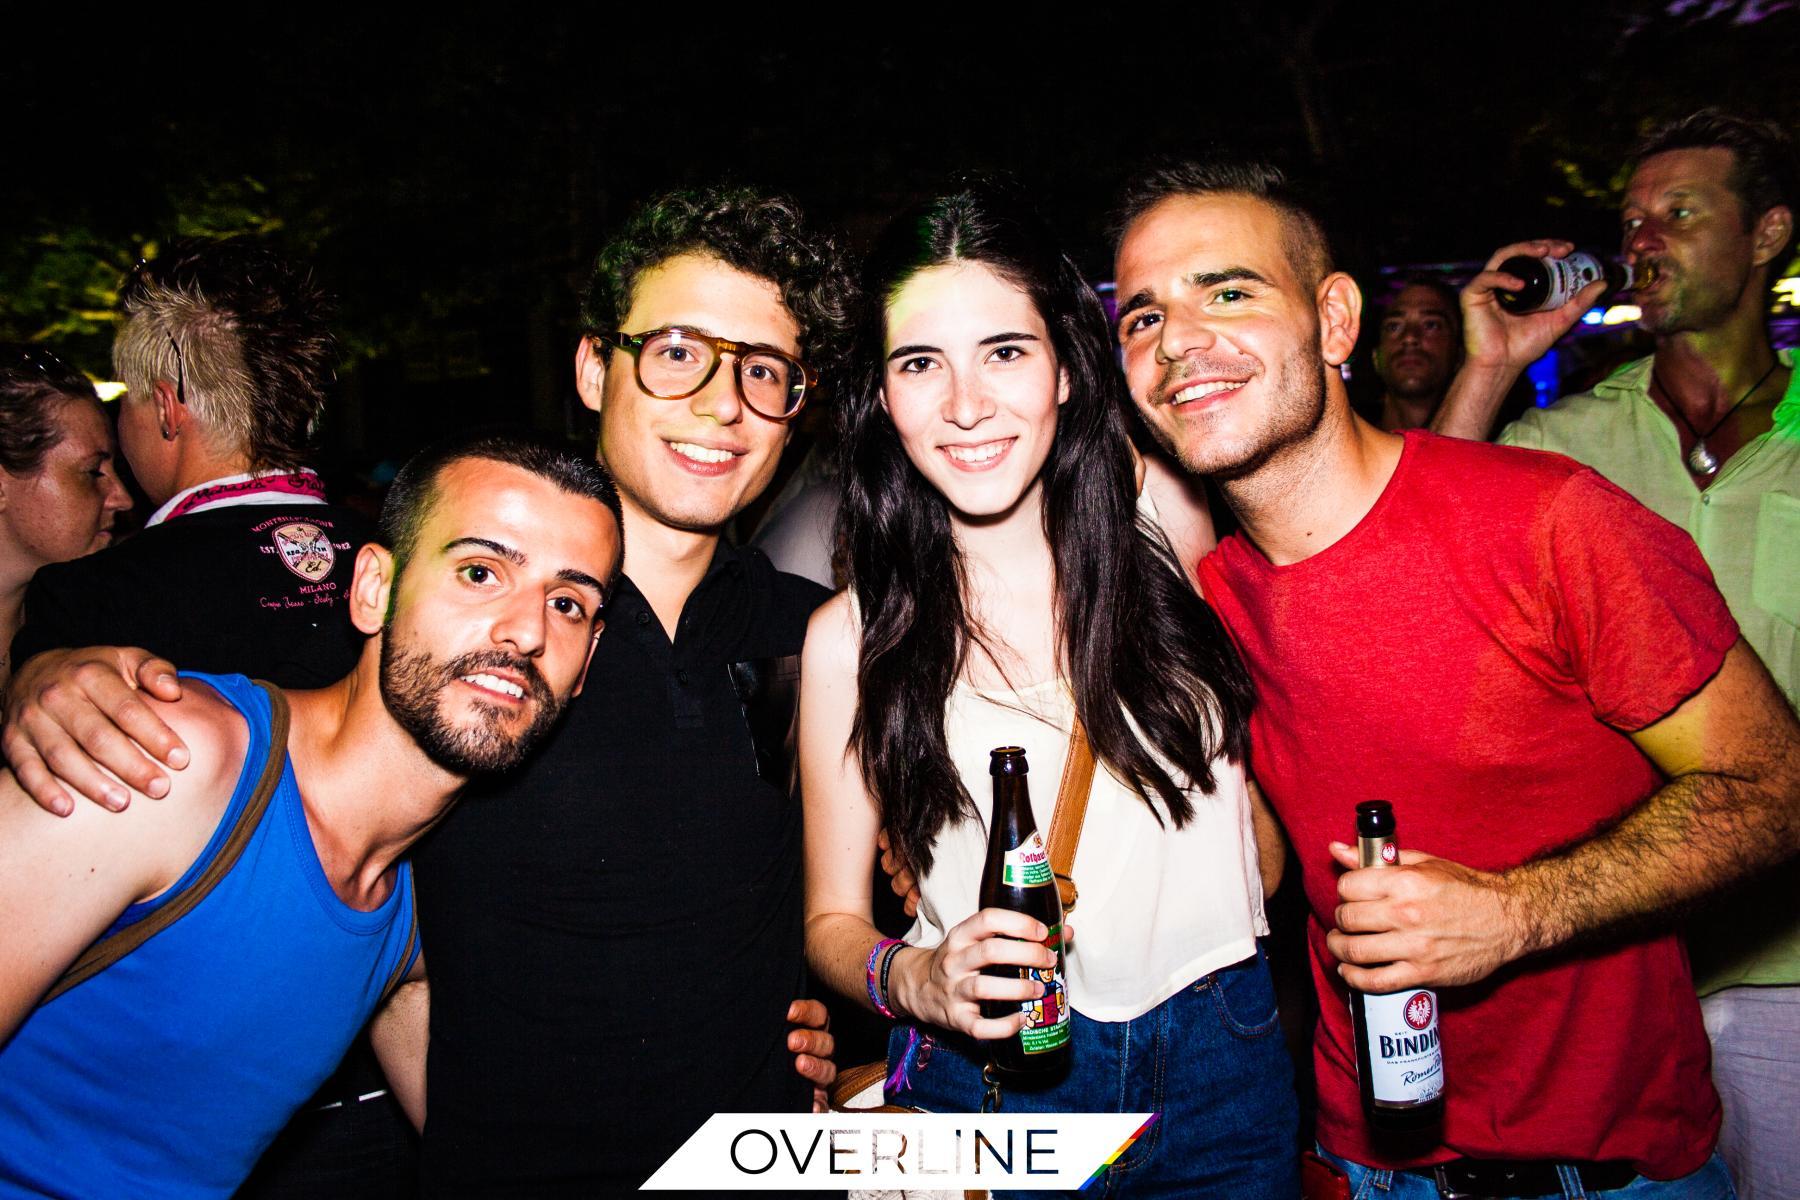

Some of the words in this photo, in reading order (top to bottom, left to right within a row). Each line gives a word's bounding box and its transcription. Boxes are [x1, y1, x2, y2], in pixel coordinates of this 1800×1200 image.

[299, 582, 337, 594] MILANO
[1022, 1027, 1049, 1035] BADISCHE
[1379, 1027, 1441, 1059] BINDIN
